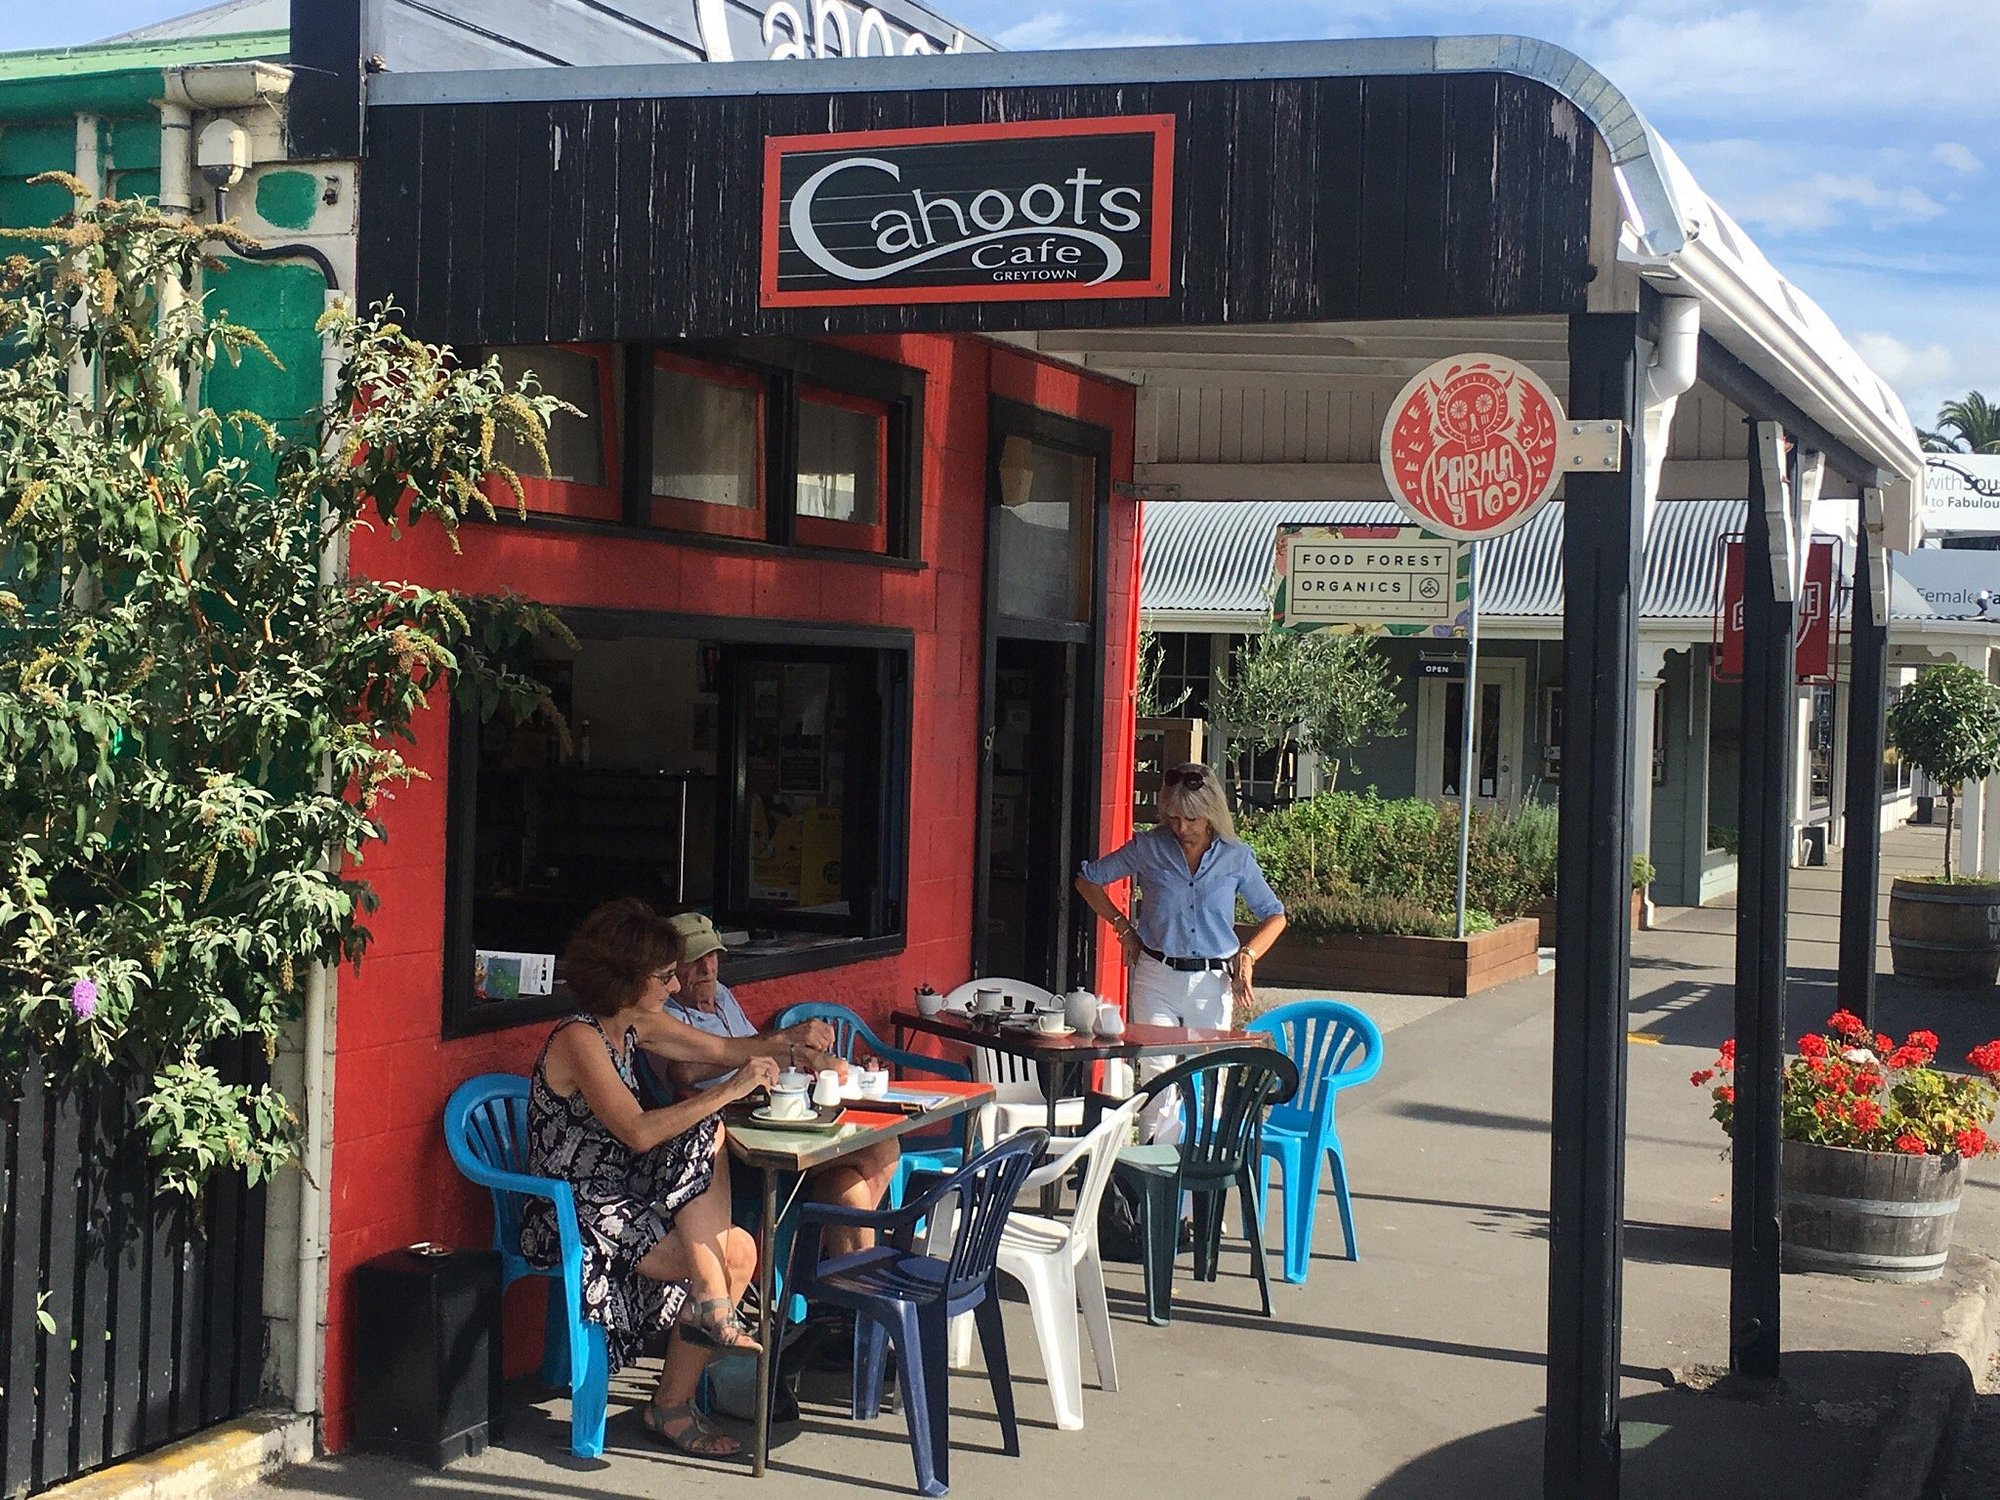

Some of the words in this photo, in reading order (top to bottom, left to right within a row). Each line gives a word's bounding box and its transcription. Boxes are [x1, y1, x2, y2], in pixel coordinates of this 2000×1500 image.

[789, 156, 1142, 287] Cahoots
[971, 238, 1082, 270] Cafe
[992, 269, 1078, 281] GREYTOWN
[1432, 444, 1514, 503] KARMA
[1932, 497, 1944, 507] to
[1302, 554, 1354, 566] FOOD
[1367, 554, 1443, 567] FOREST
[1302, 580, 1402, 593] ORGANICS
[1425, 665, 1450, 674] OPEN
